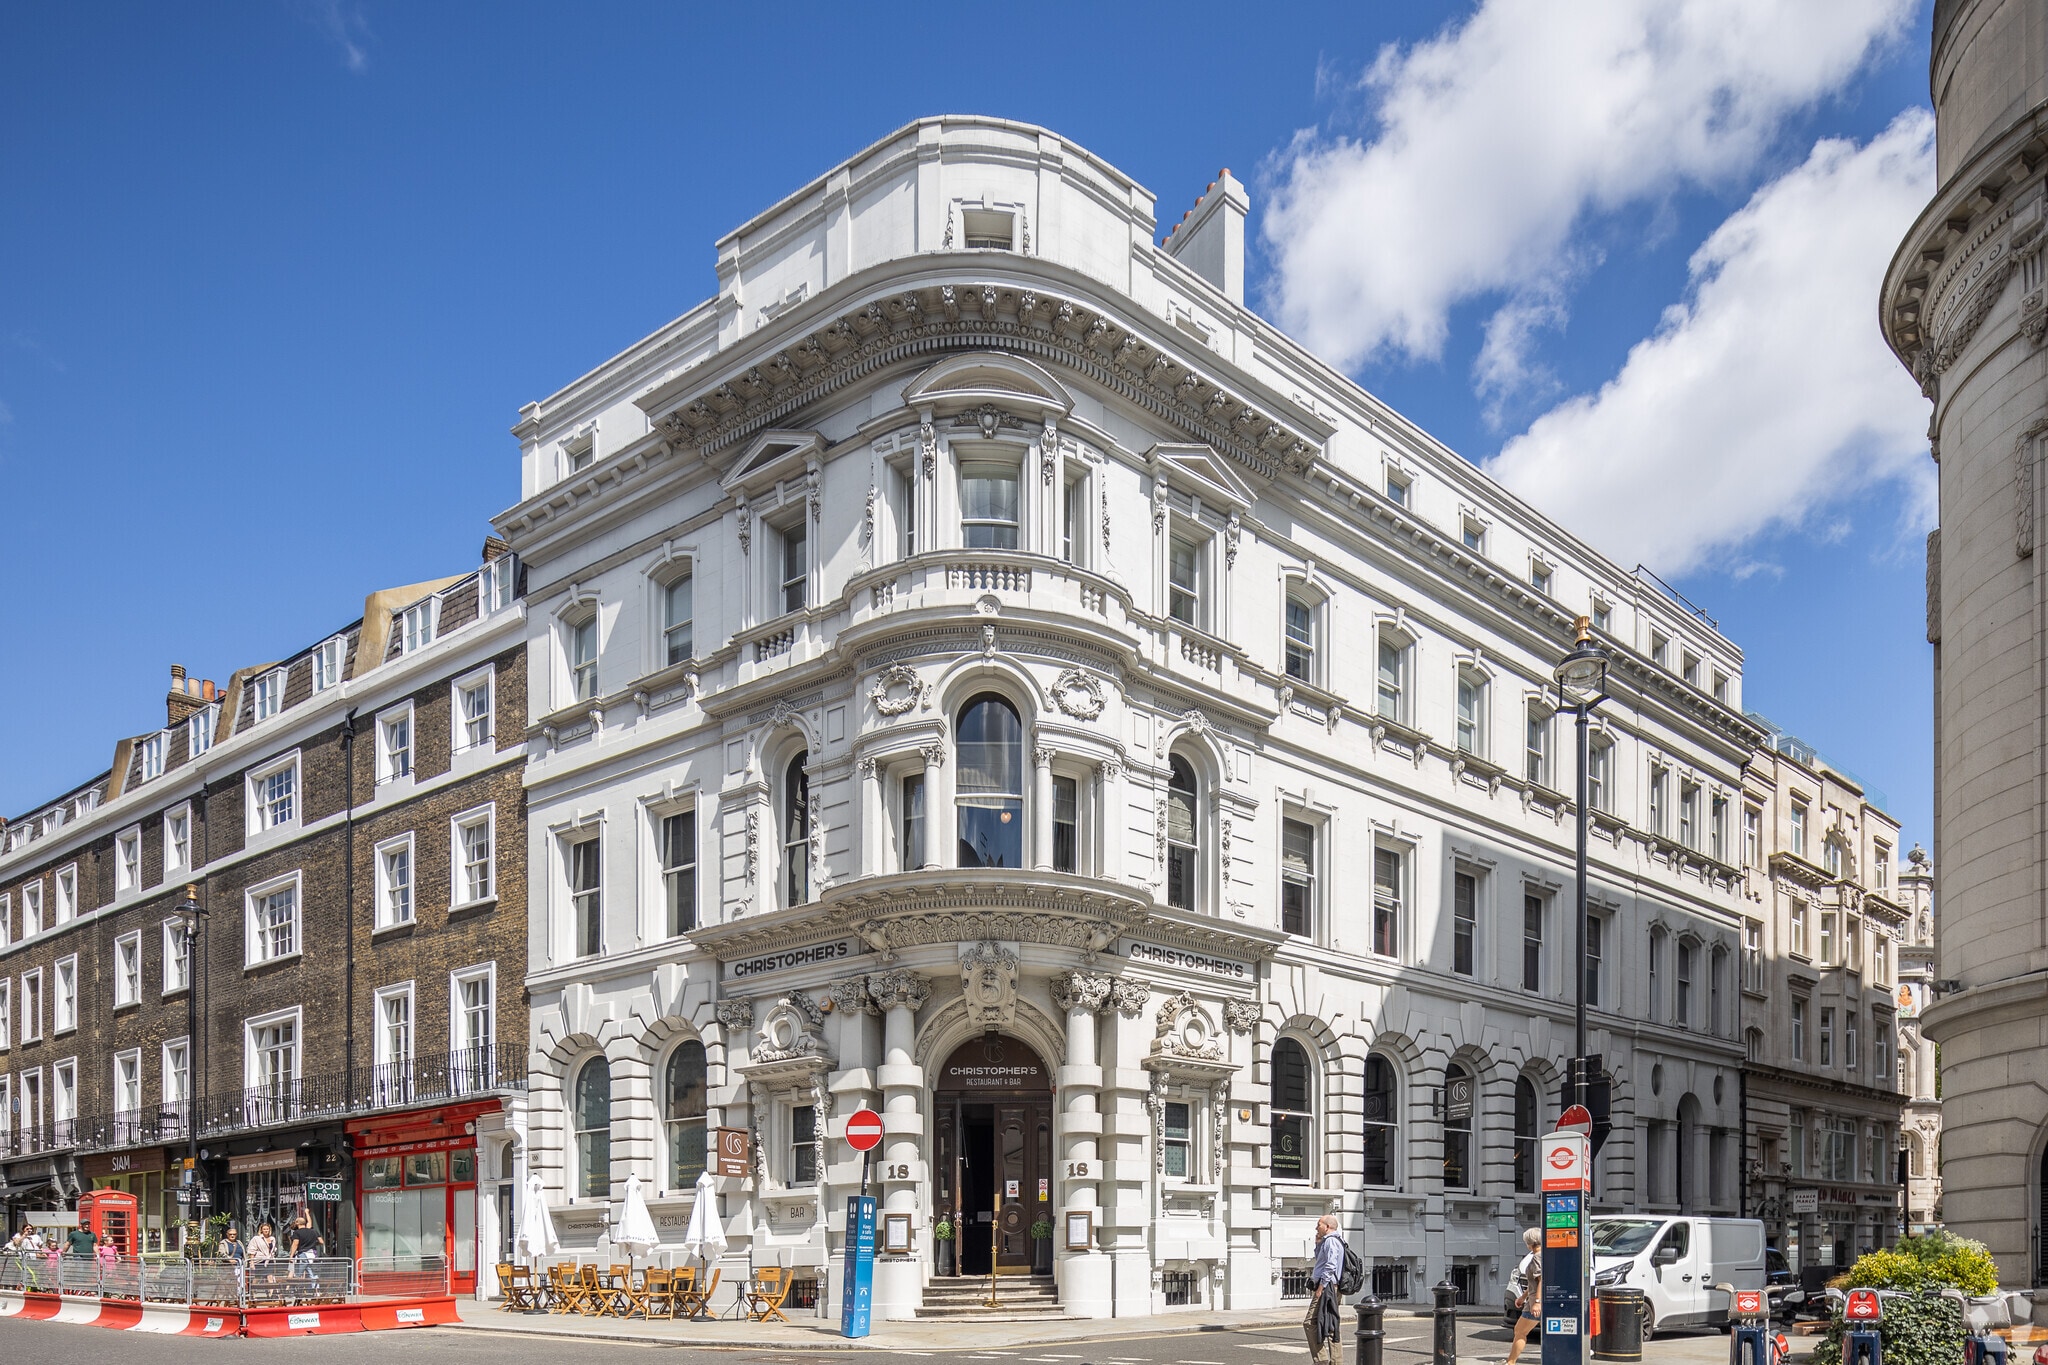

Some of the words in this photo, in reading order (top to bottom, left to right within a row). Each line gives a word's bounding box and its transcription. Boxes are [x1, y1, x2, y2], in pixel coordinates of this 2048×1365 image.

[734, 942, 847, 976] CHRISTOPHER'S
[1130, 944, 1243, 977] CHRISTOPHER'S
[950, 1066, 1037, 1075] CHRISTOPHER'S
[966, 1078, 1002, 1086] RESTAURANT
[112, 1155, 130, 1171] SIAM
[408, 1157, 444, 1172] Garden
[456, 1157, 471, 1174] 20
[1068, 1162, 1088, 1176] 18
[888, 1165, 909, 1179] 18
[1830, 1188, 1856, 1204] MANCA
[791, 1207, 804, 1218] BAR
[568, 1222, 604, 1230] CHRISTOPHER'S
[660, 1216, 691, 1227] RESTAURA
[290, 1316, 318, 1324] CONWAY
[1550, 1321, 1558, 1331] P
